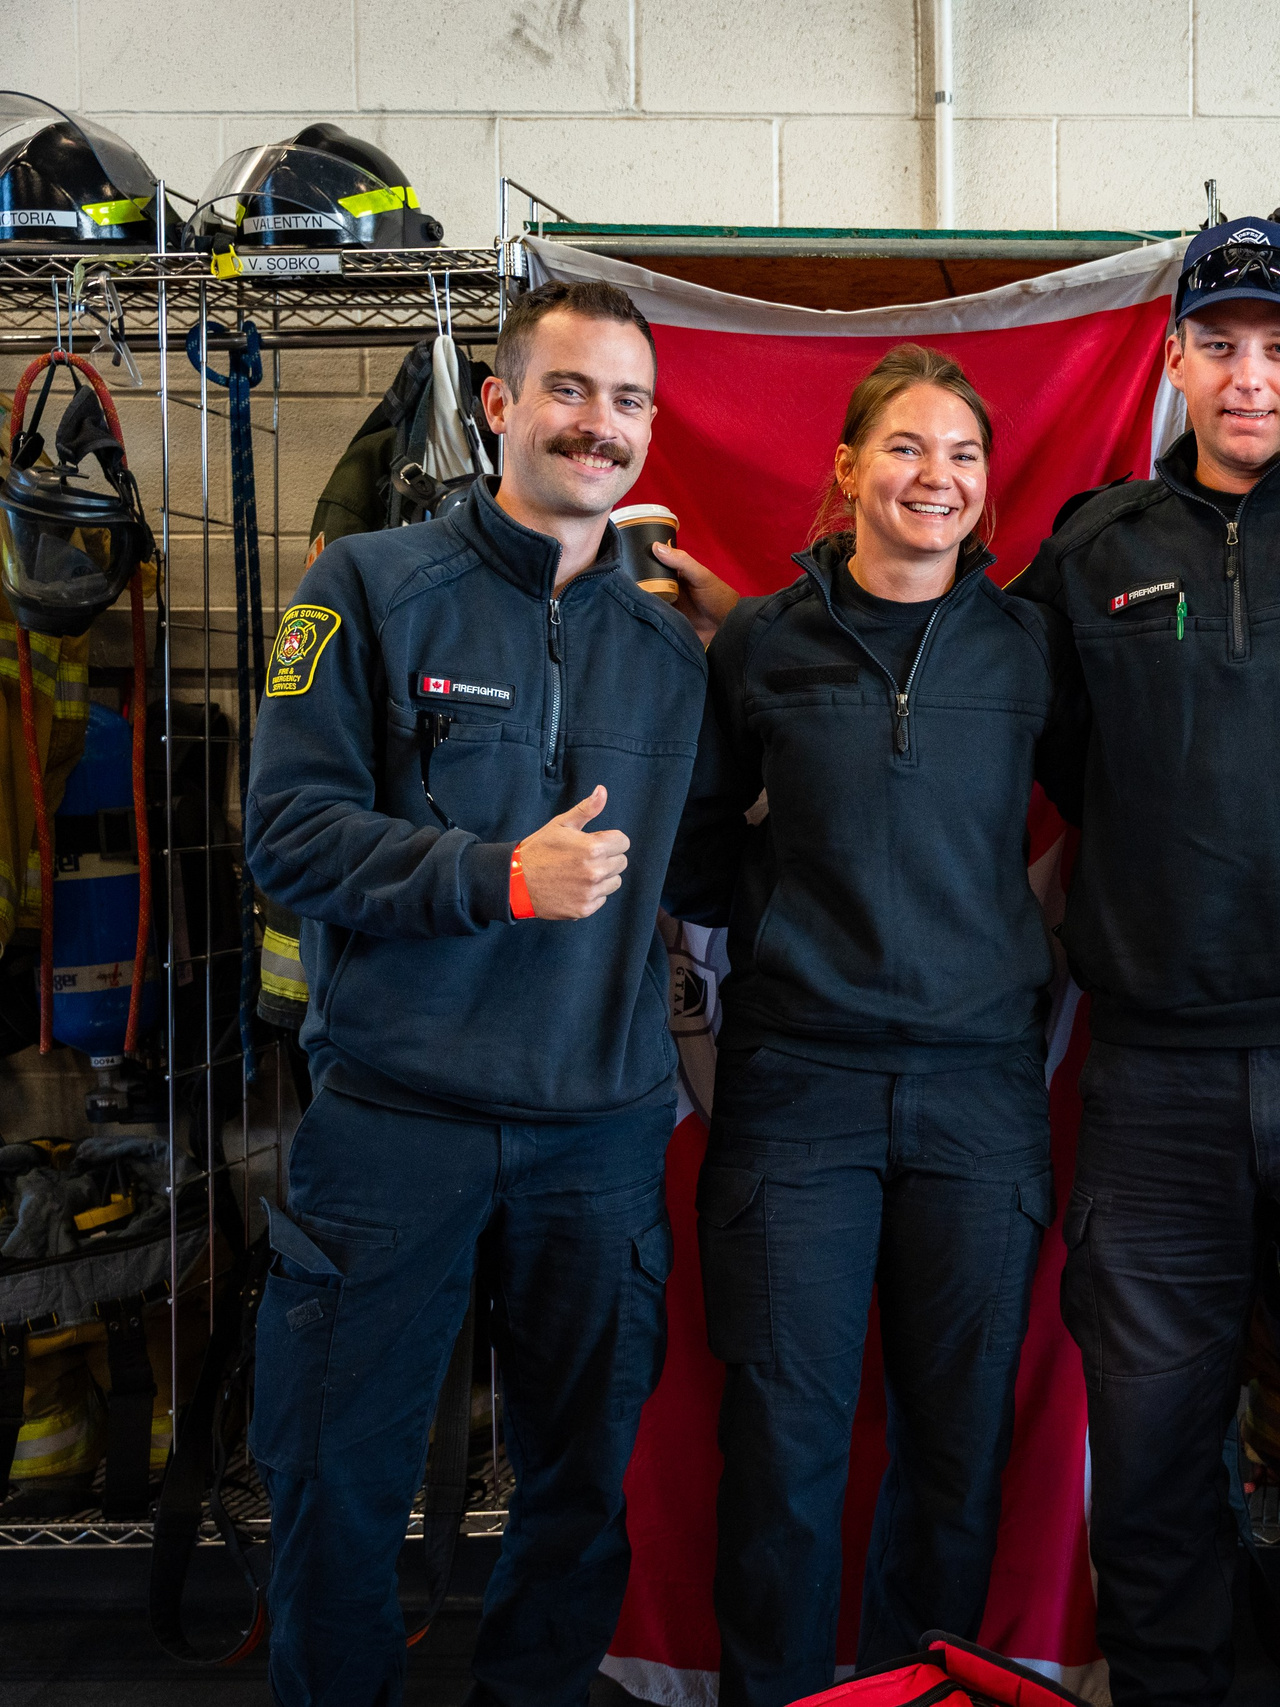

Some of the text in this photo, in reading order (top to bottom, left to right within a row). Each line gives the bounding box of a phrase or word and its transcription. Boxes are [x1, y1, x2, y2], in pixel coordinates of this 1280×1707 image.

[0, 212, 56, 225] CTORIA
[253, 216, 323, 230] VALENTYN
[248, 257, 320, 270] V. SOBKO
[1129, 581, 1175, 601] FIREFIGHTER
[300, 609, 329, 621] SOUND
[452, 683, 510, 700] FIREFIGHTER
[674, 966, 684, 1017] GTAA
